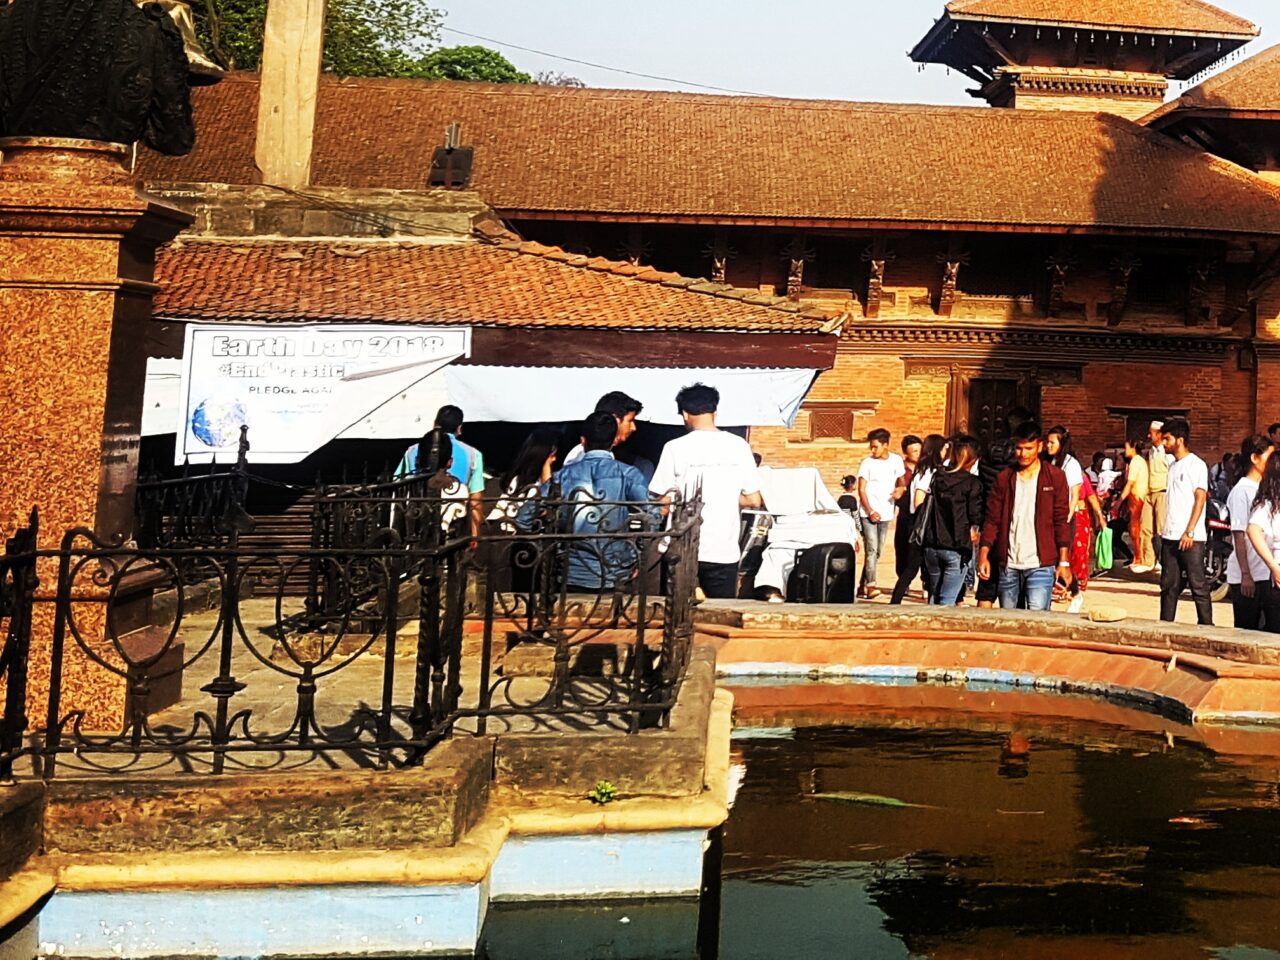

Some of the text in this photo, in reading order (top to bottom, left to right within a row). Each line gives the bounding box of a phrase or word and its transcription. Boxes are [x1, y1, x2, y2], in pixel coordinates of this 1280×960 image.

[212, 335, 445, 359] Earth Day 2018
